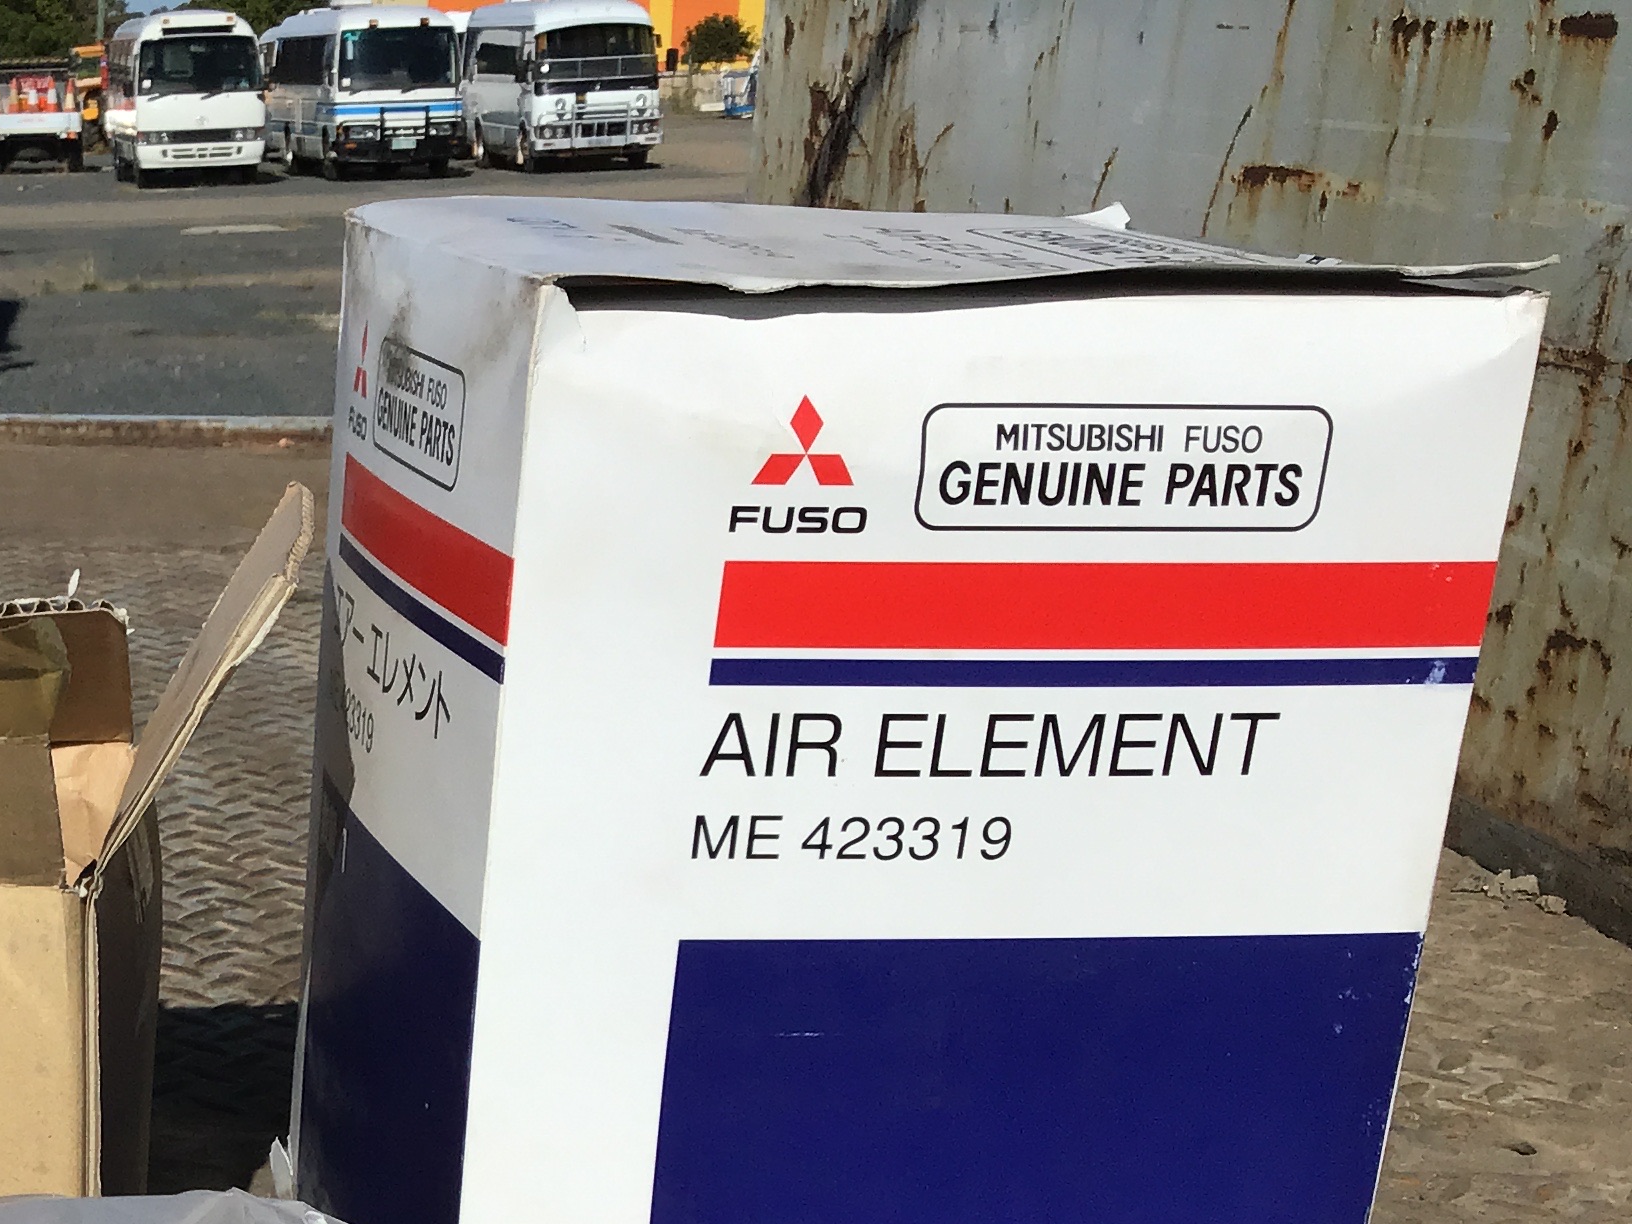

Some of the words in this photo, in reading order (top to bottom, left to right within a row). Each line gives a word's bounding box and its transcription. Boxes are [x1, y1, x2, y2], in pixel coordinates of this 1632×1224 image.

[427, 377, 448, 410] FUSO
[348, 405, 368, 441] FUSO
[377, 387, 418, 446] GENUINE
[419, 410, 455, 466] PARTS
[995, 423, 1165, 453] MITSUBISHI
[1183, 425, 1264, 454] FUSO
[938, 460, 1143, 507] GENUINE
[1164, 462, 1304, 507] PARTS
[728, 505, 868, 535] FUSO
[699, 712, 844, 778] AIR
[873, 712, 1281, 778] ELEMENT
[690, 814, 784, 861] ME
[800, 816, 1013, 862] 423319
